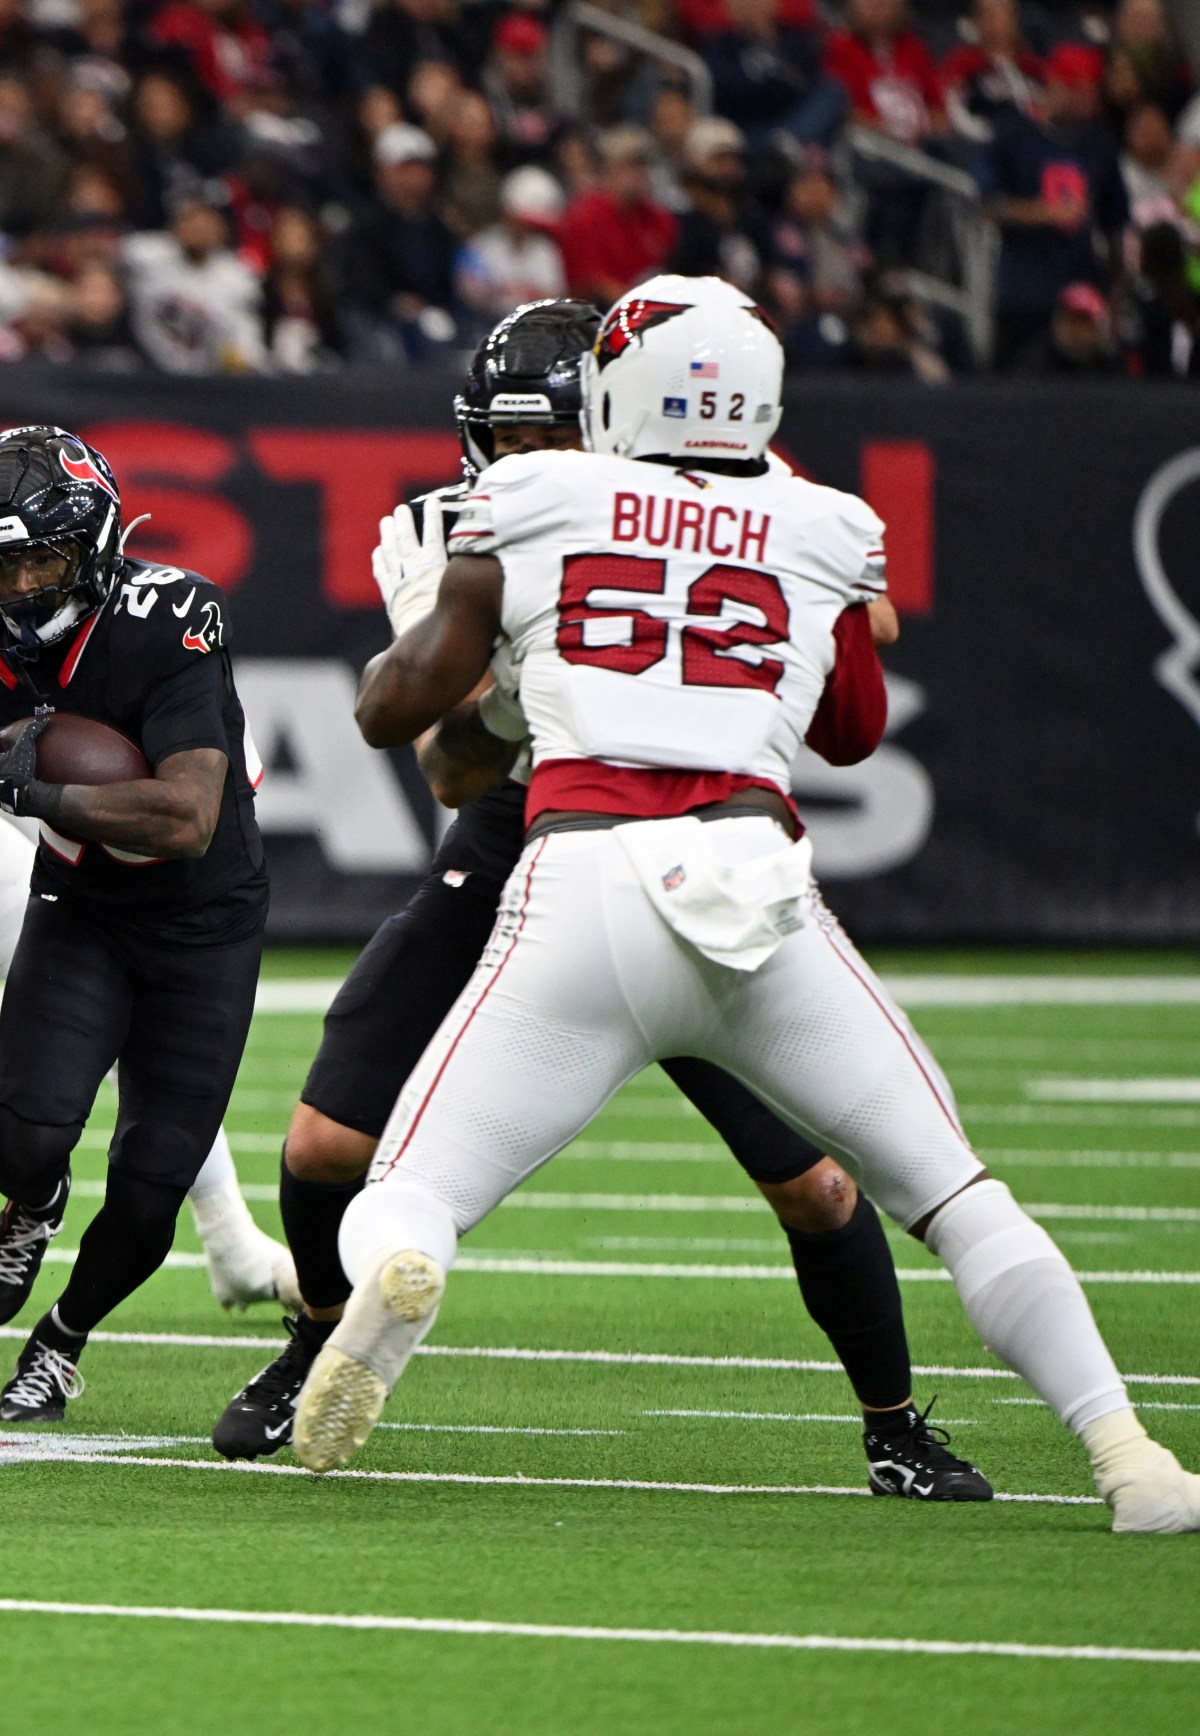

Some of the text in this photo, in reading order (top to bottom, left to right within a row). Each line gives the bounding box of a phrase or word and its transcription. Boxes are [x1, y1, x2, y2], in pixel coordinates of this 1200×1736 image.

[684, 439, 748, 450] CARDINALS
[612, 491, 771, 563] BURCH
[556, 553, 791, 700] 52
